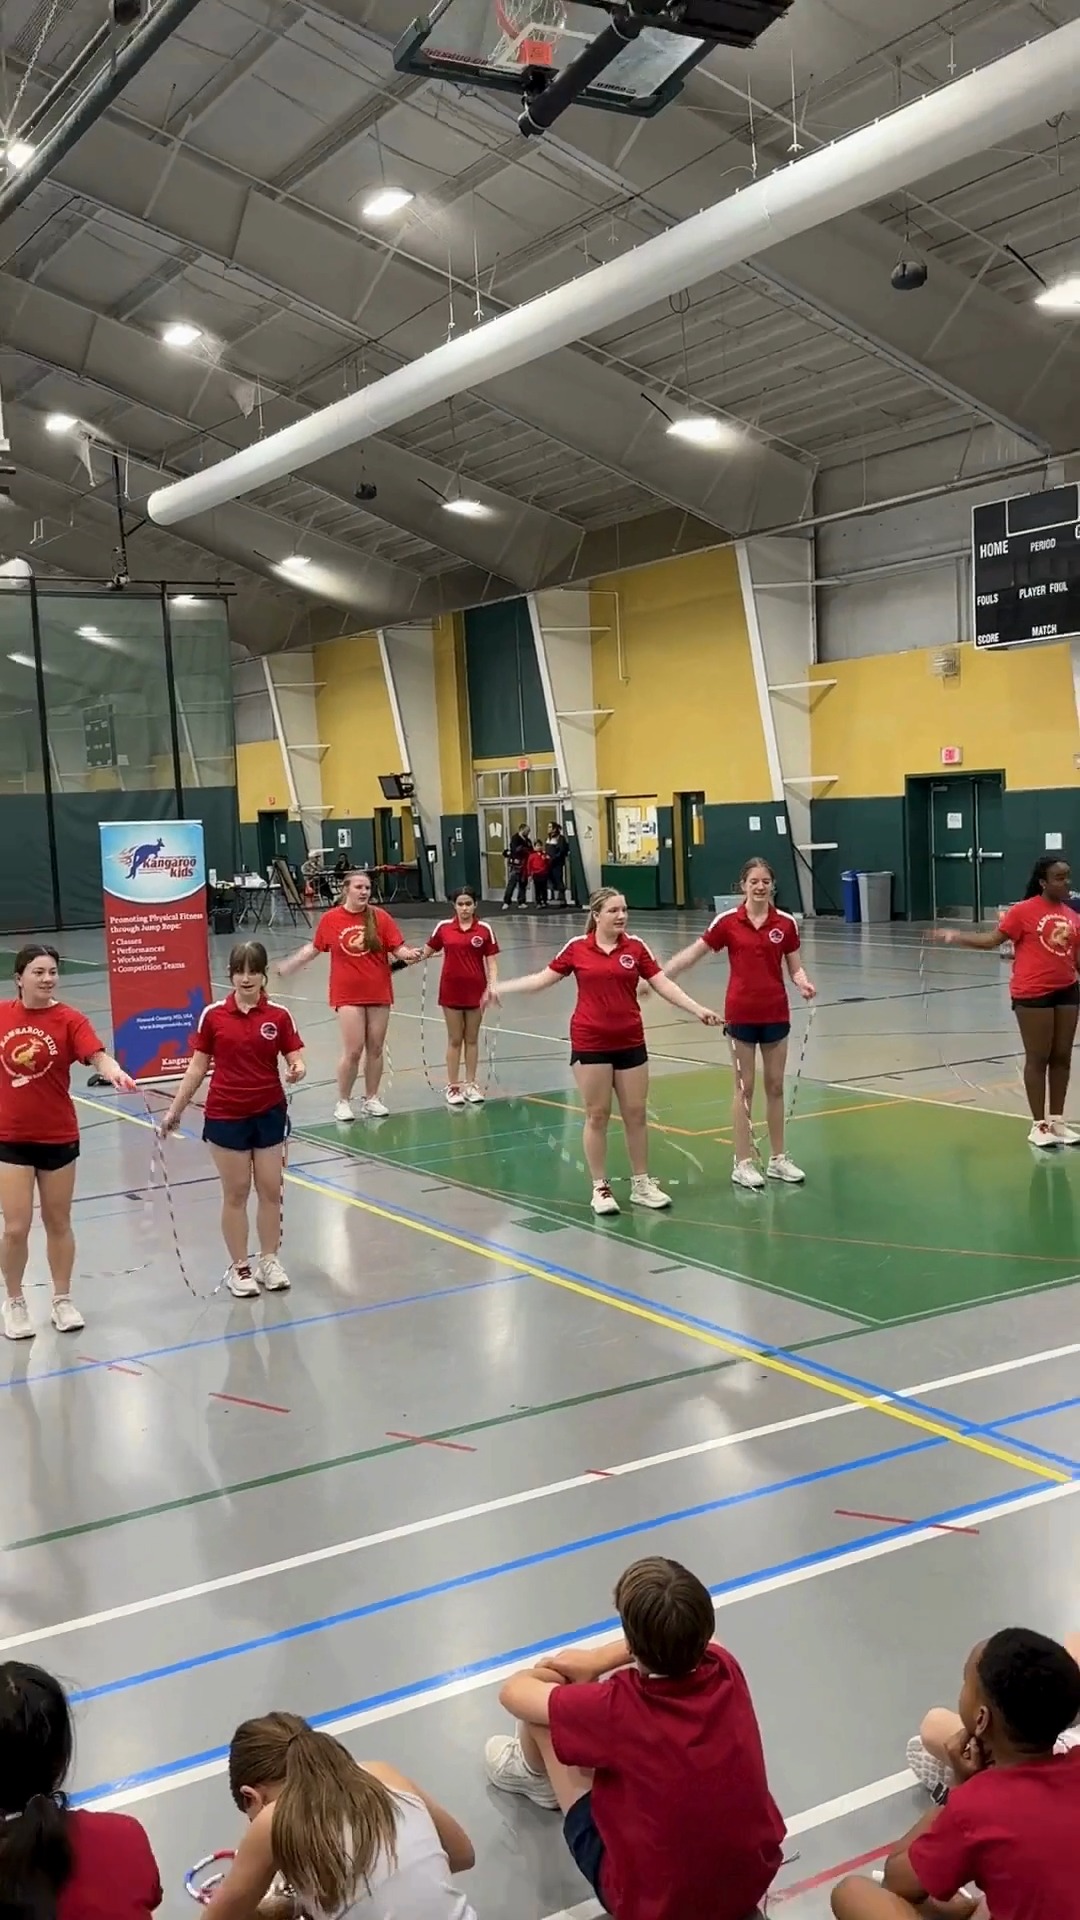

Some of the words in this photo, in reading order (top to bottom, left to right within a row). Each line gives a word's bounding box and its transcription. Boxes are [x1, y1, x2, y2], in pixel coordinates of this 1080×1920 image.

[980, 540, 1009, 559] HOME
[1030, 538, 1056, 552] PERIOD
[1019, 585, 1046, 599] PLAYER
[1049, 581, 1068, 593] FOUL
[977, 593, 999, 606] FOULS
[1032, 624, 1057, 636] MATCH
[978, 633, 999, 645] SCORE
[142, 858, 197, 870] Kangaroo
[170, 867, 194, 878] kids
[110, 915, 148, 924] Promoting
[149, 913, 178, 922] Physical
[180, 912, 203, 920] Fitness
[110, 925, 140, 933] through
[141, 924, 161, 932] Jump
[117, 945, 165, 954] Performances
[118, 955, 157, 963] Workshops
[118, 963, 161, 973] Competition
[162, 962, 185, 970] Teams
